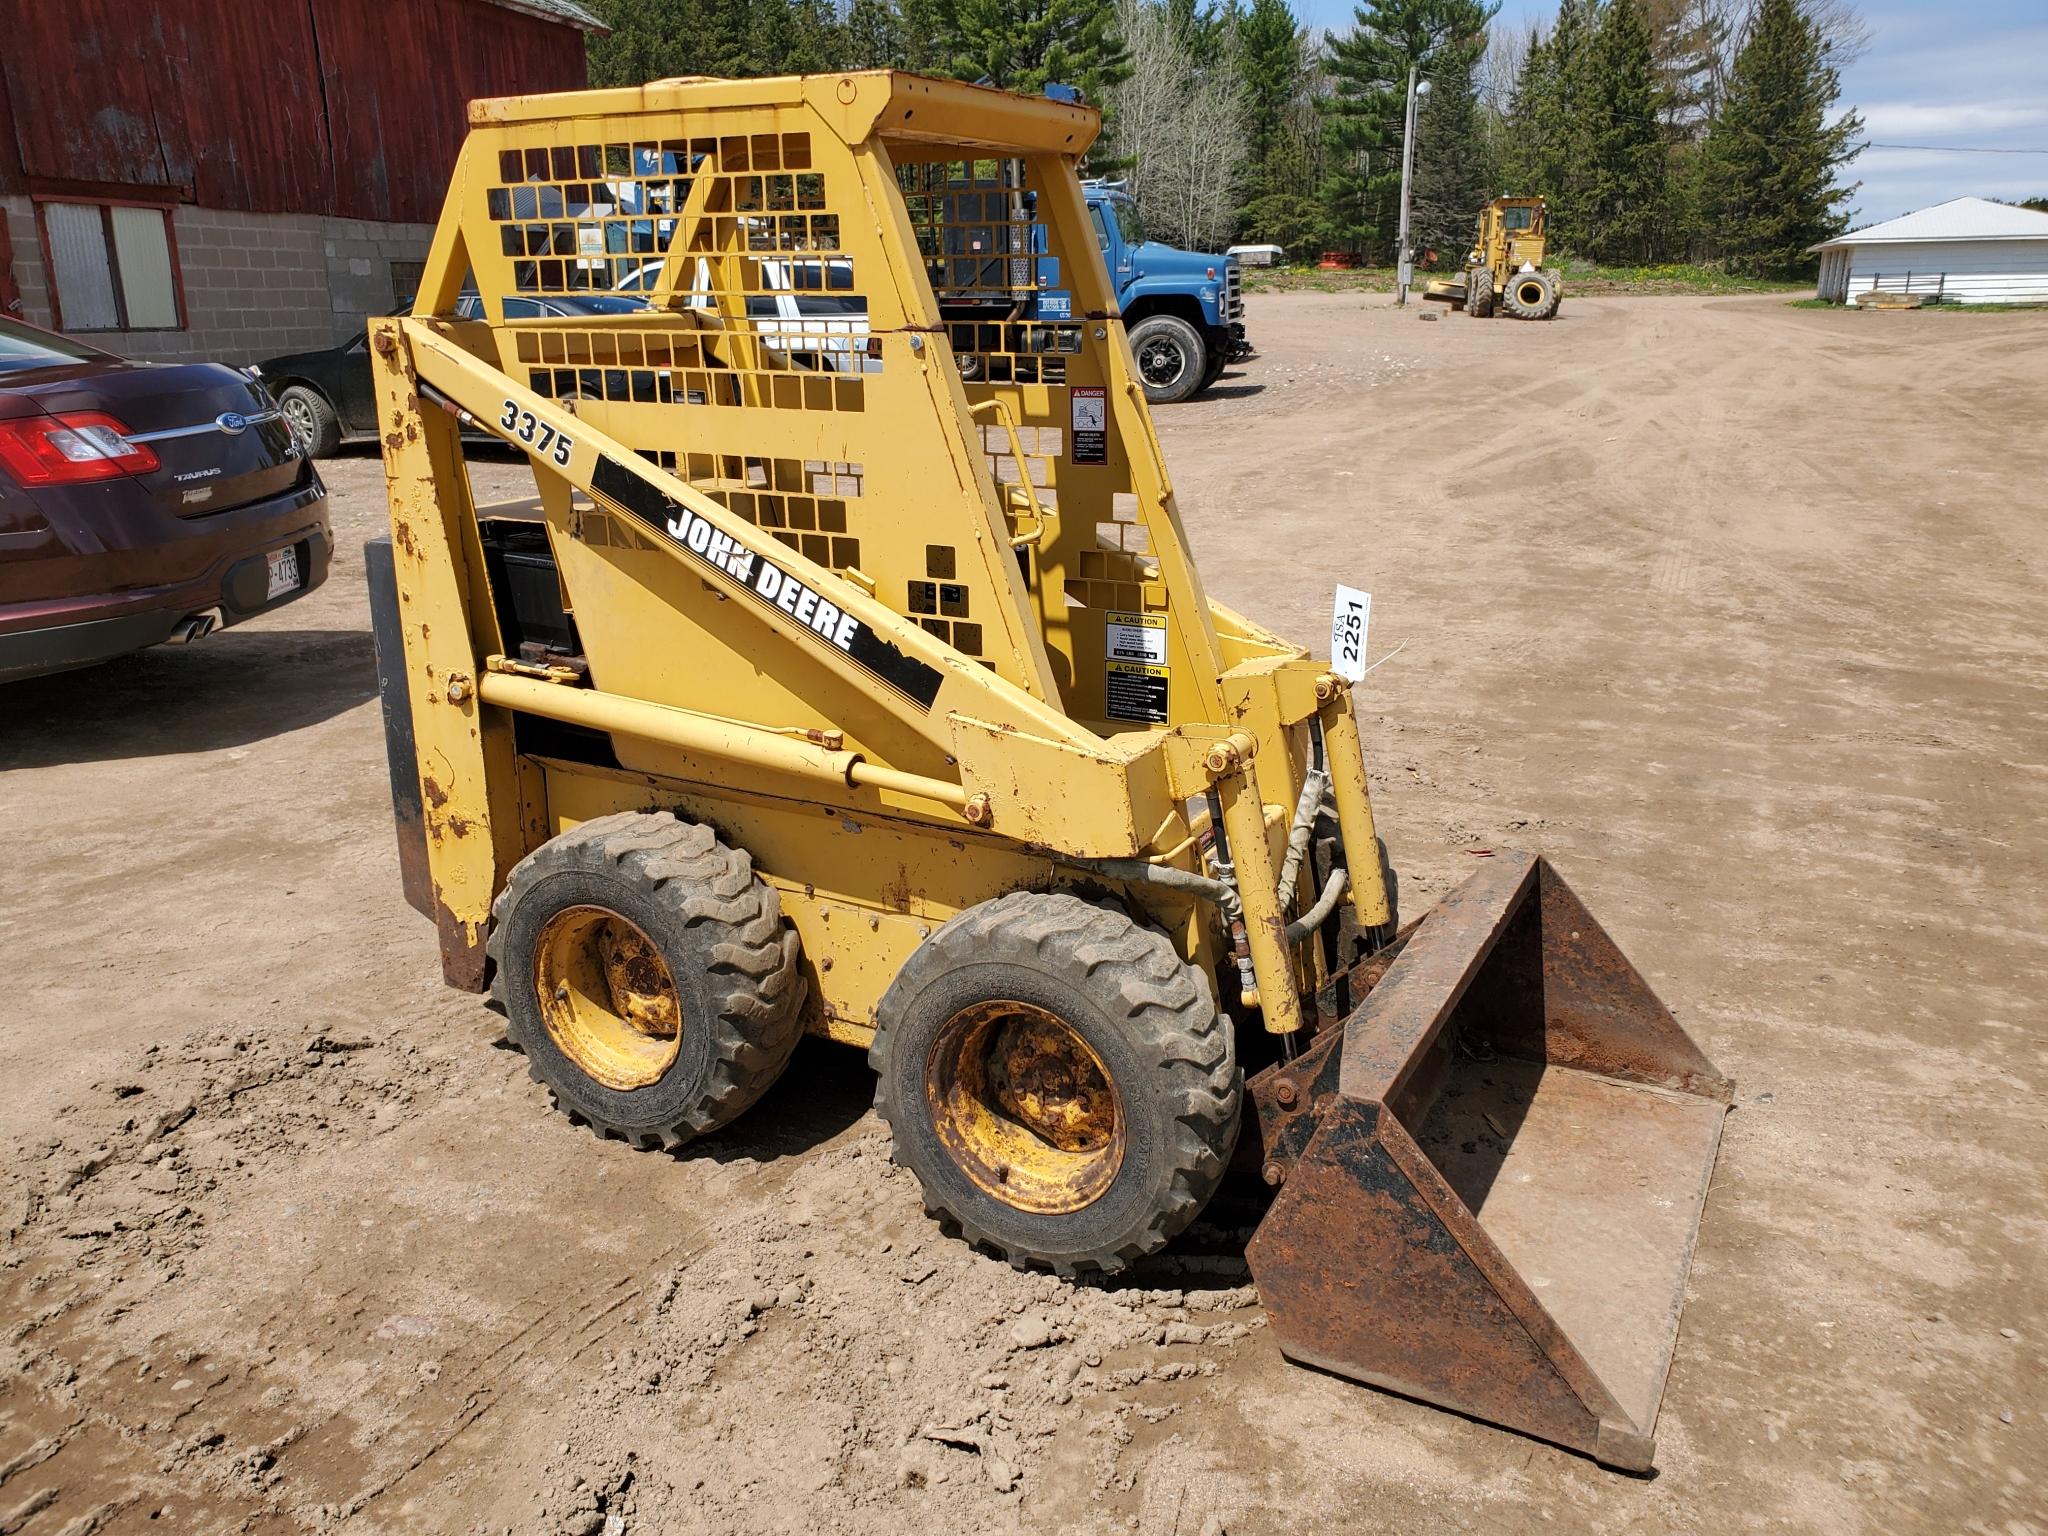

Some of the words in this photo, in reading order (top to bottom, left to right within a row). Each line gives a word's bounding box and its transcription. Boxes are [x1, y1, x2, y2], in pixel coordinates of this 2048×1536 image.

[227, 415, 244, 428] Ford
[499, 398, 574, 467] 3375
[174, 467, 222, 482] TAURUS
[667, 508, 755, 583] JOHN
[755, 561, 859, 651] DEERE
[1124, 616, 1158, 625] CAUTION
[1343, 601, 1363, 663] 2251
[1124, 665, 1161, 675] CAUTION
